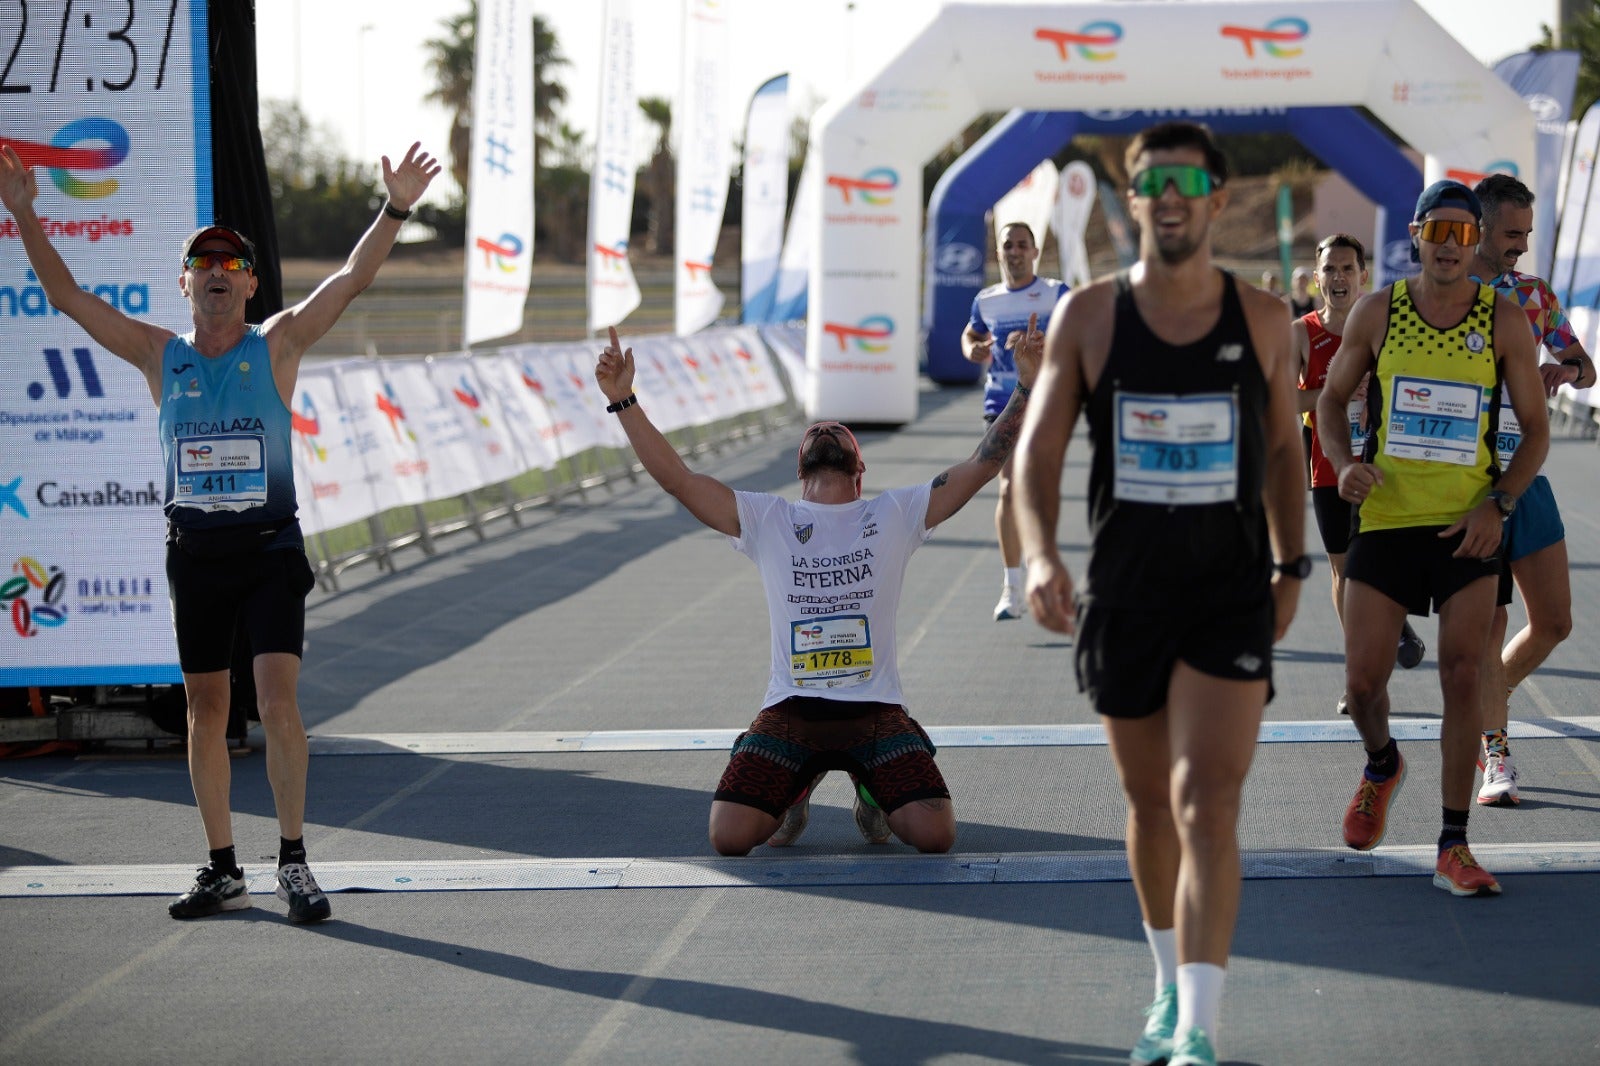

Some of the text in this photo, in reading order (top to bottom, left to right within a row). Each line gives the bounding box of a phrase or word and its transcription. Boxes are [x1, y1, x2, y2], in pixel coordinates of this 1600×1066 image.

[1418, 418, 1452, 437] 177
[1155, 448, 1198, 470] 703
[202, 475, 235, 491] 411
[36, 481, 161, 507] CaixaBank
[791, 548, 874, 568] LA SONRISA
[793, 564, 873, 588] ETERNA
[810, 651, 852, 668] 1778
